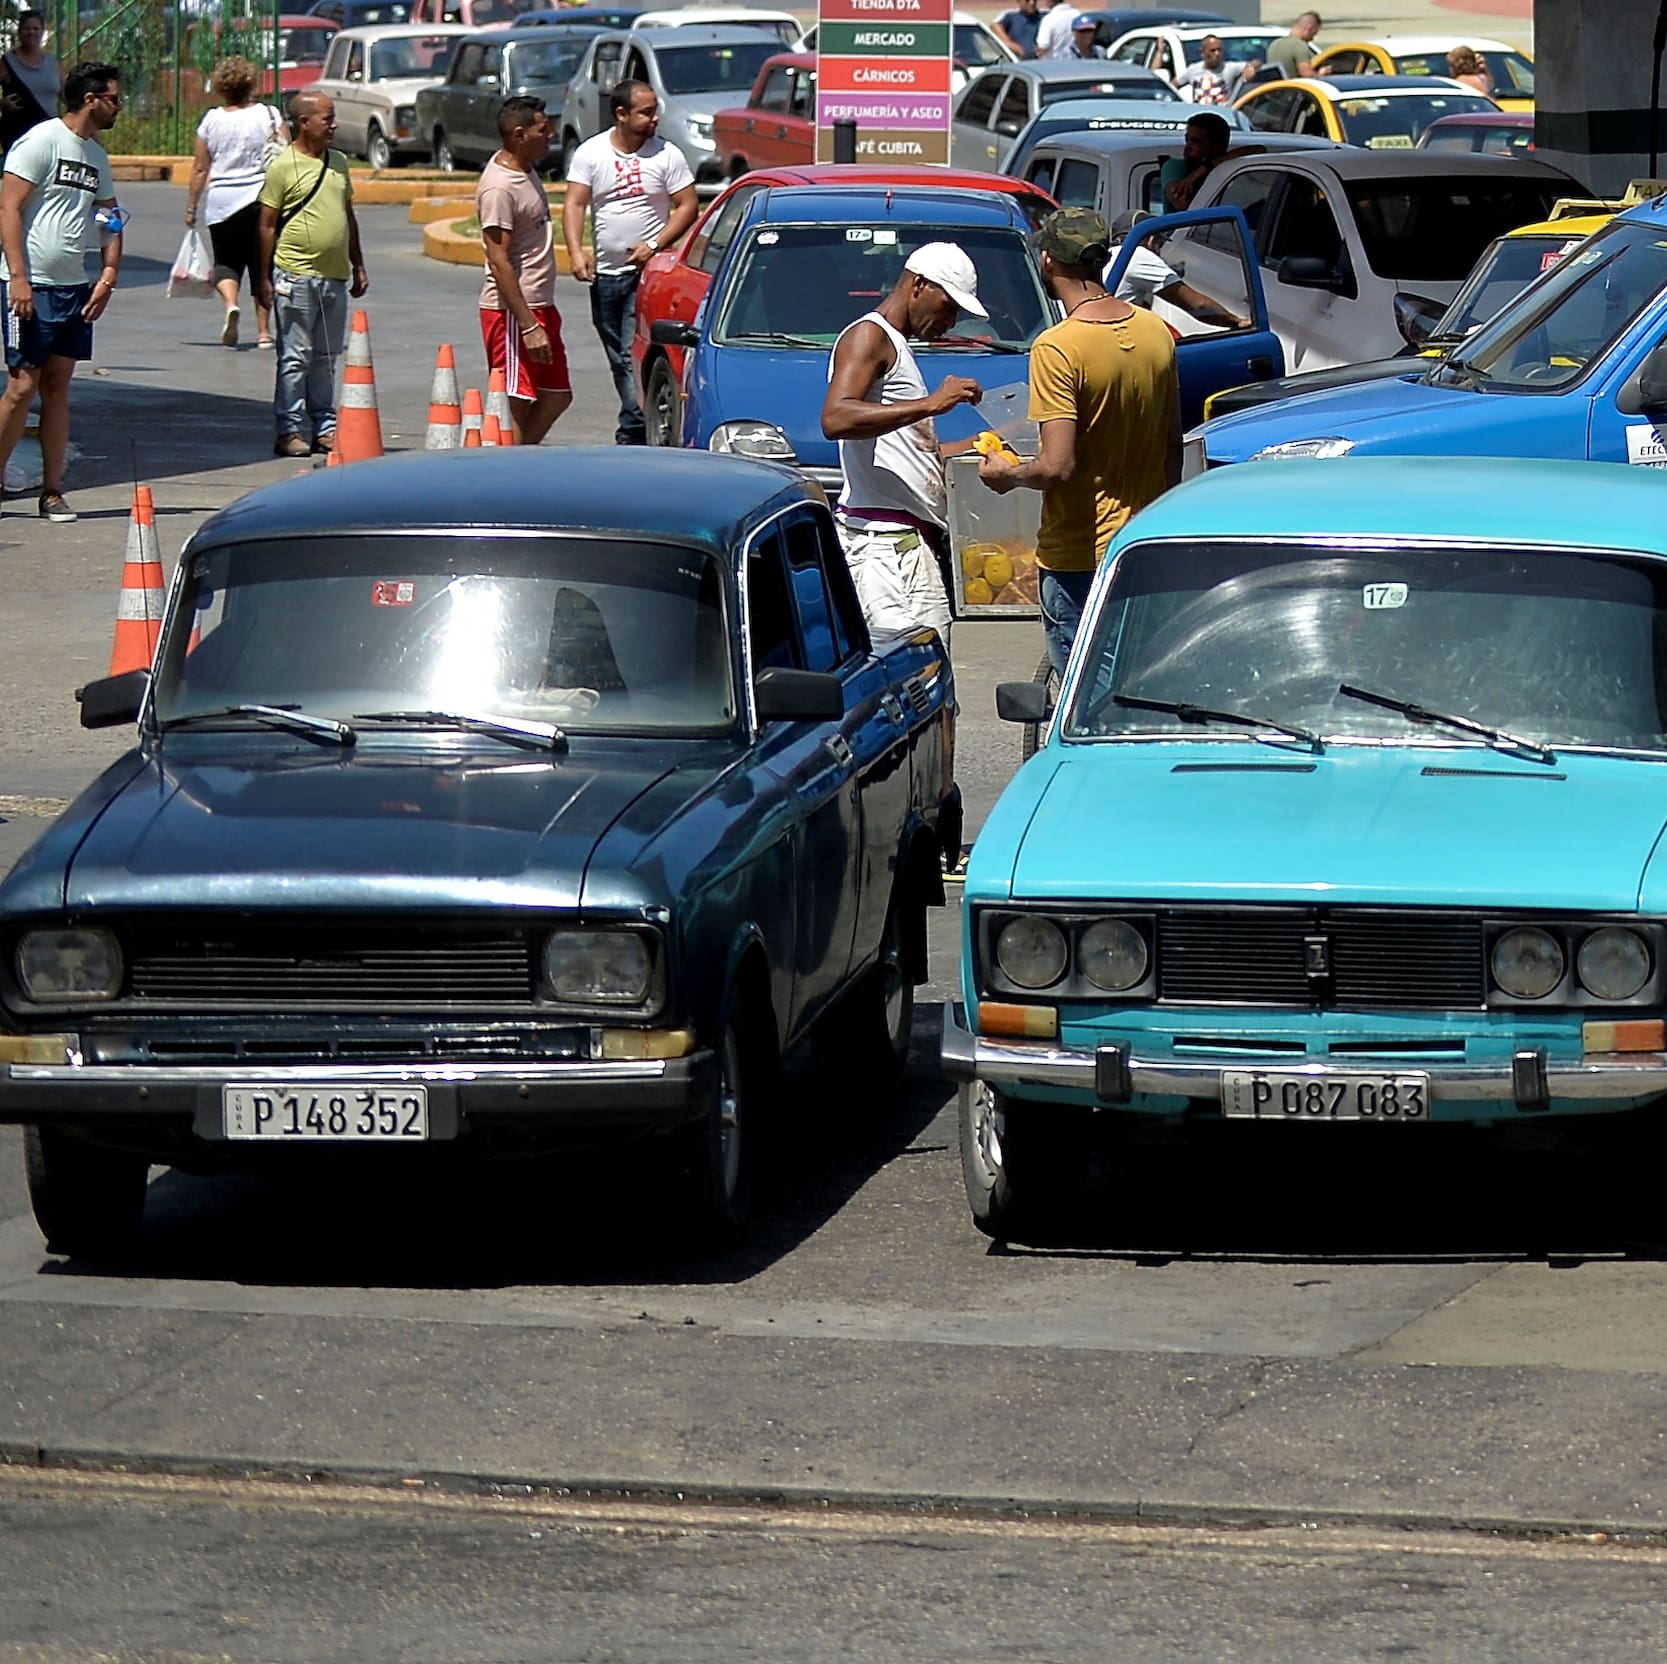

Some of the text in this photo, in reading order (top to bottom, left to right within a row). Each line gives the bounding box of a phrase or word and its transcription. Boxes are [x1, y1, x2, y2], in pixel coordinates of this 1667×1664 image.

[854, 33, 916, 46] MERCADO
[853, 68, 915, 83] CÁRNICOS
[824, 105, 943, 119] PERFUMERÍA Y ASEO
[856, 139, 923, 155] FÉ CUBITA
[1366, 587, 1390, 606] 17
[1252, 1078, 1424, 1116] P 087 083
[252, 1094, 421, 1136] P 148 352
